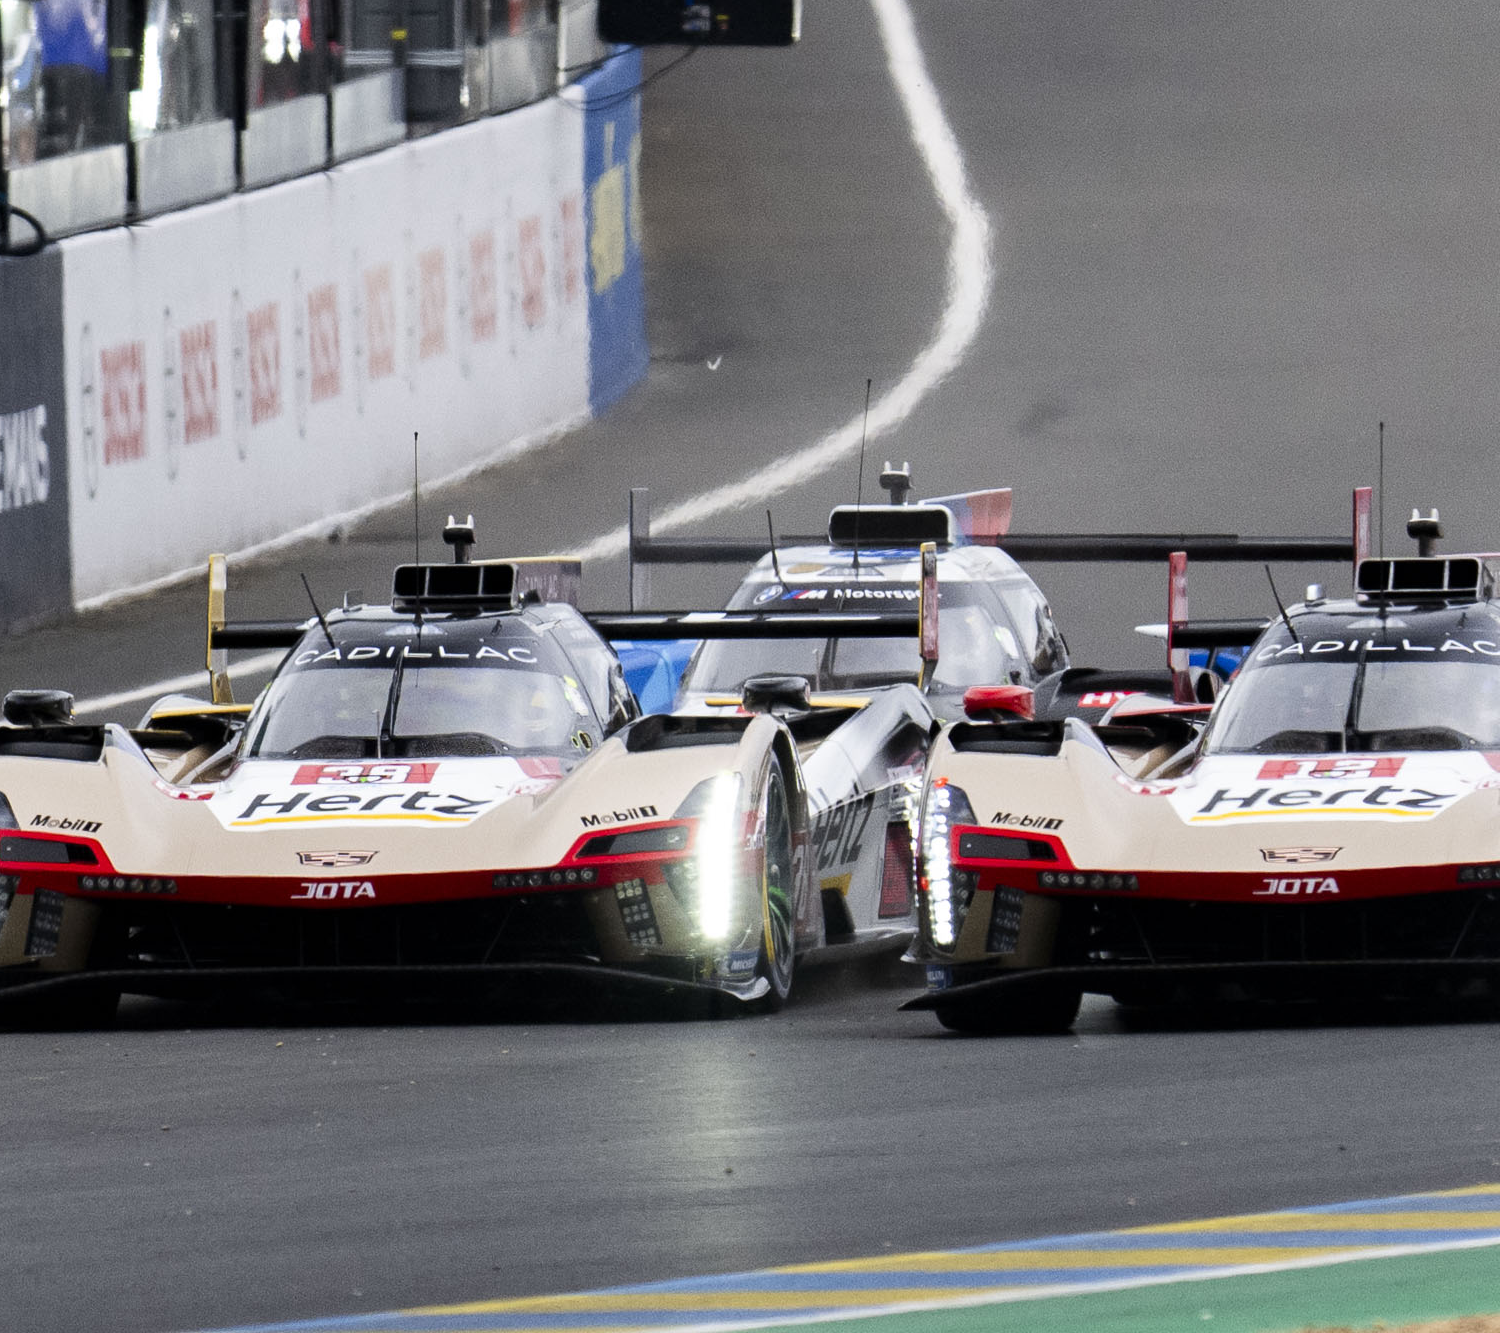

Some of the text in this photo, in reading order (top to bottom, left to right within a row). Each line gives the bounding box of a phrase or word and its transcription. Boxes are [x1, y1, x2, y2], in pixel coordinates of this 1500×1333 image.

[833, 588, 942, 601] Motorsp
[294, 644, 539, 666] CADILLAC
[236, 789, 493, 819] Hertz
[1198, 784, 1460, 814] Hertz
[290, 881, 376, 900] JOTA
[1252, 877, 1340, 896] JOTA
